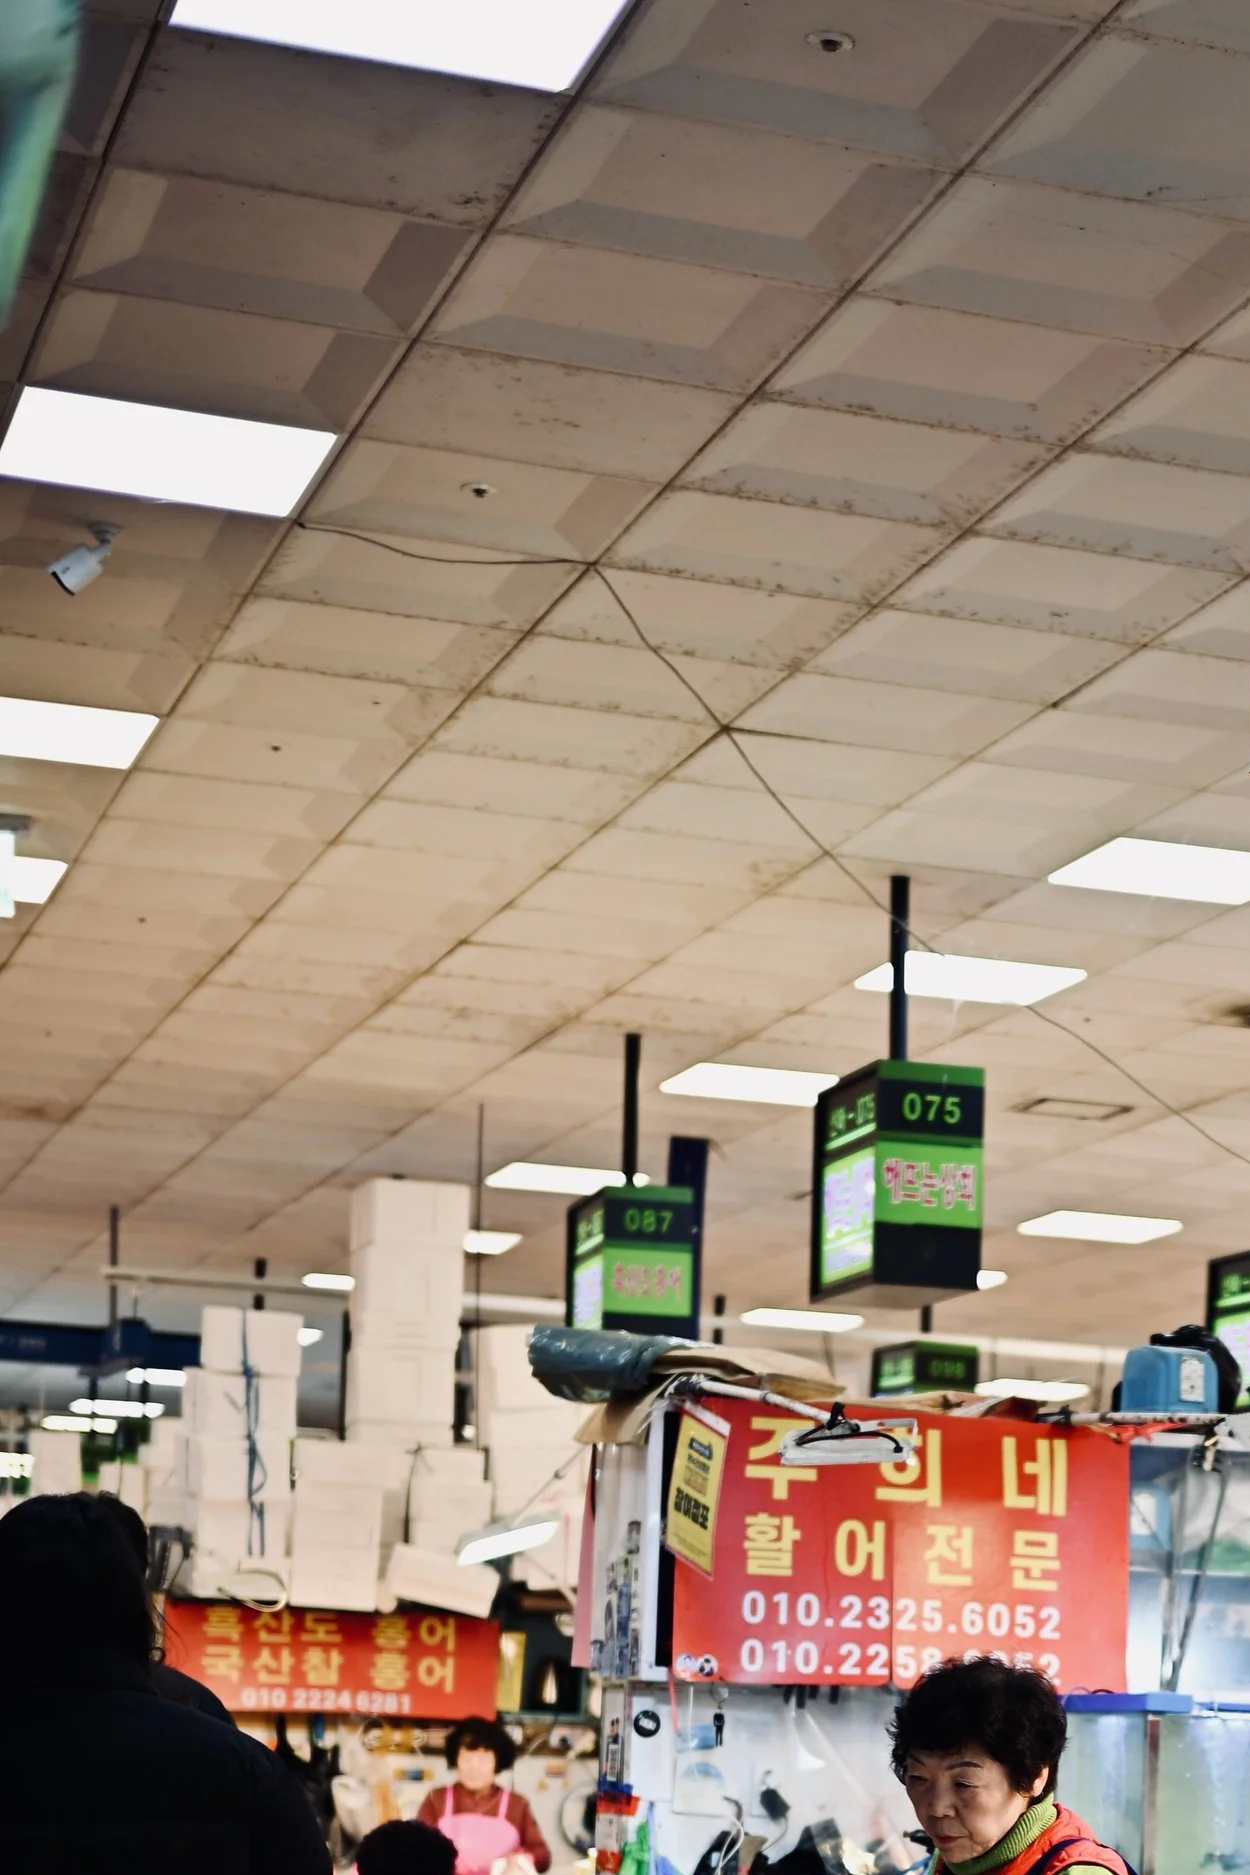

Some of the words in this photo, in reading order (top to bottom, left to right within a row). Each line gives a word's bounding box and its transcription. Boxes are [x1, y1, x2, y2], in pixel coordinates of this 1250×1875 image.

[903, 1092, 961, 1124] 075
[745, 1416, 1067, 1517] 주희네
[744, 1512, 1060, 1590] 활어전문
[741, 1590, 1060, 1639] 010.2325.6052
